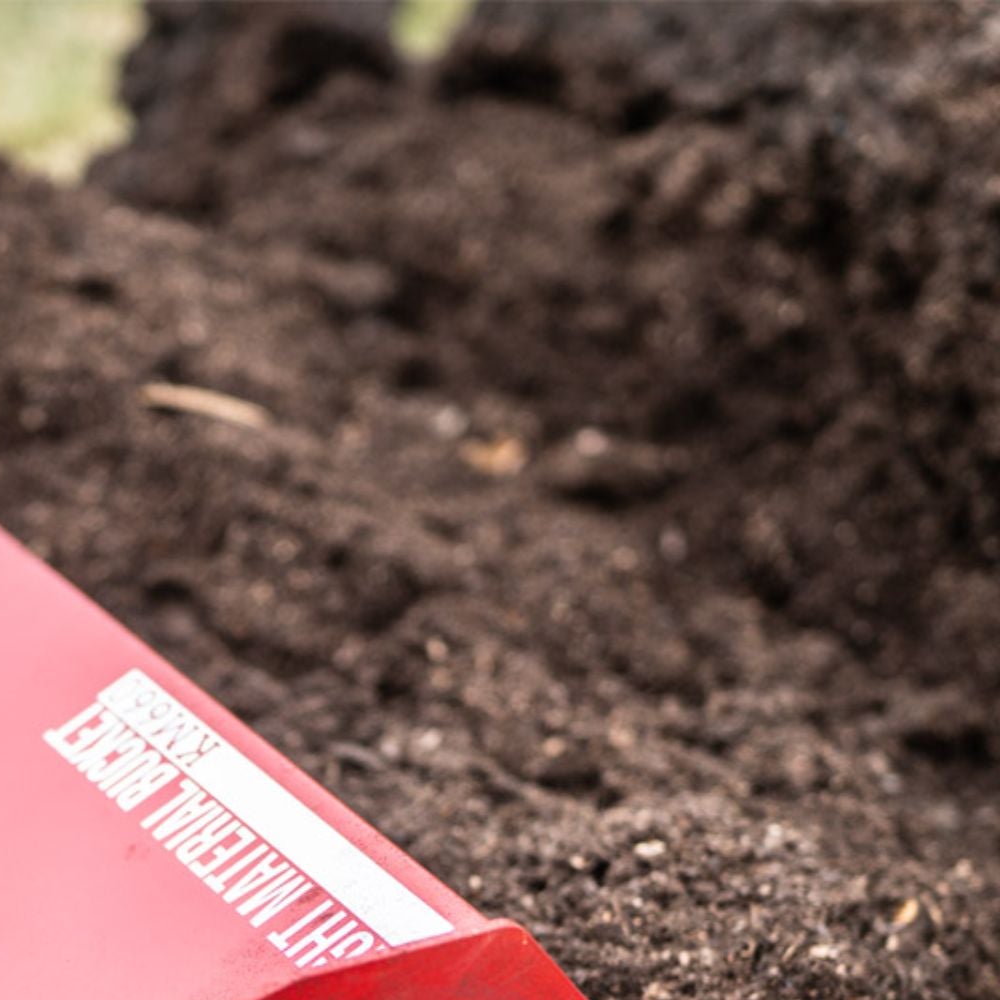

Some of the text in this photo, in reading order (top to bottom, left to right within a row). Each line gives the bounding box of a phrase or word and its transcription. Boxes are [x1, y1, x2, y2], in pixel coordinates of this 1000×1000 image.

[42, 702, 388, 968] GHT MATERIAL BUCKET
